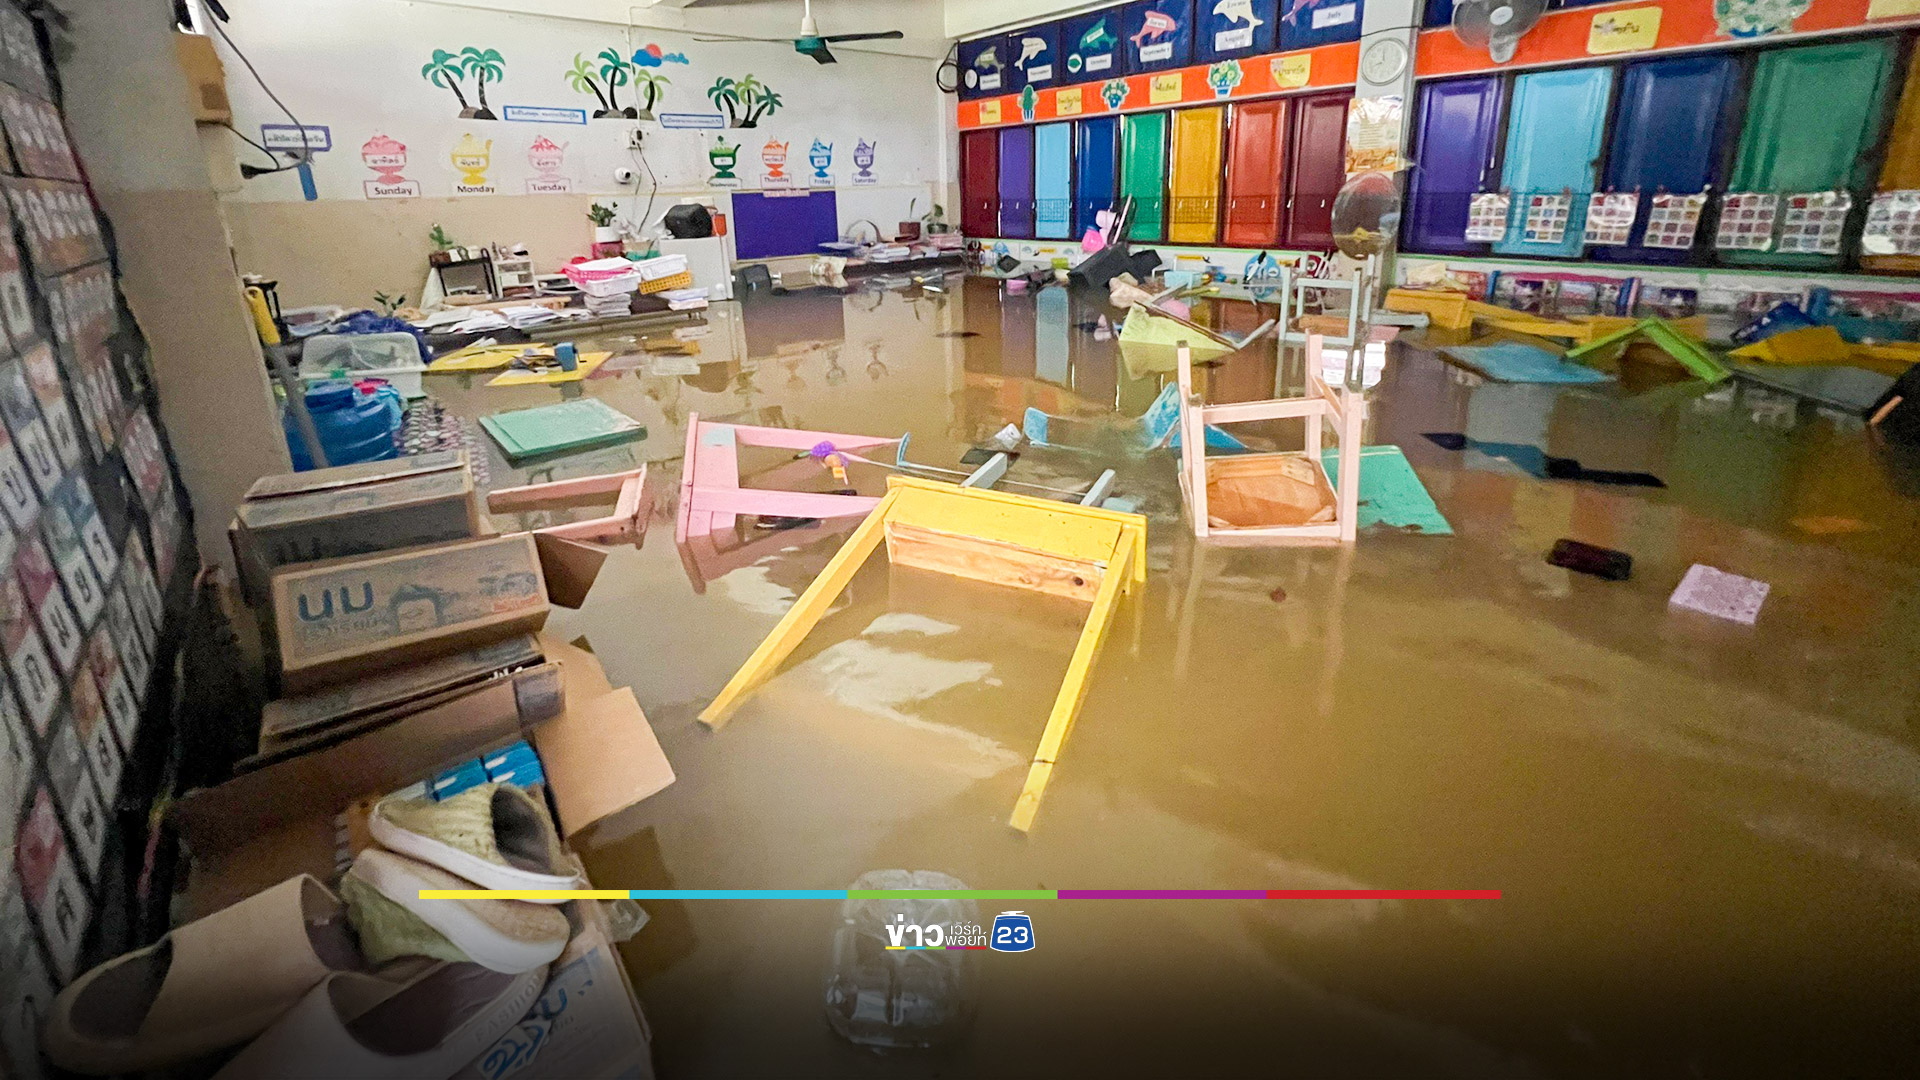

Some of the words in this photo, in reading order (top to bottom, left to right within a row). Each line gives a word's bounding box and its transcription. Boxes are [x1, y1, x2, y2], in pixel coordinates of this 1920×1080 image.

[374, 186, 412, 195] Sunday
[457, 185, 495, 194] Monday
[532, 183, 567, 192] Tuesday
